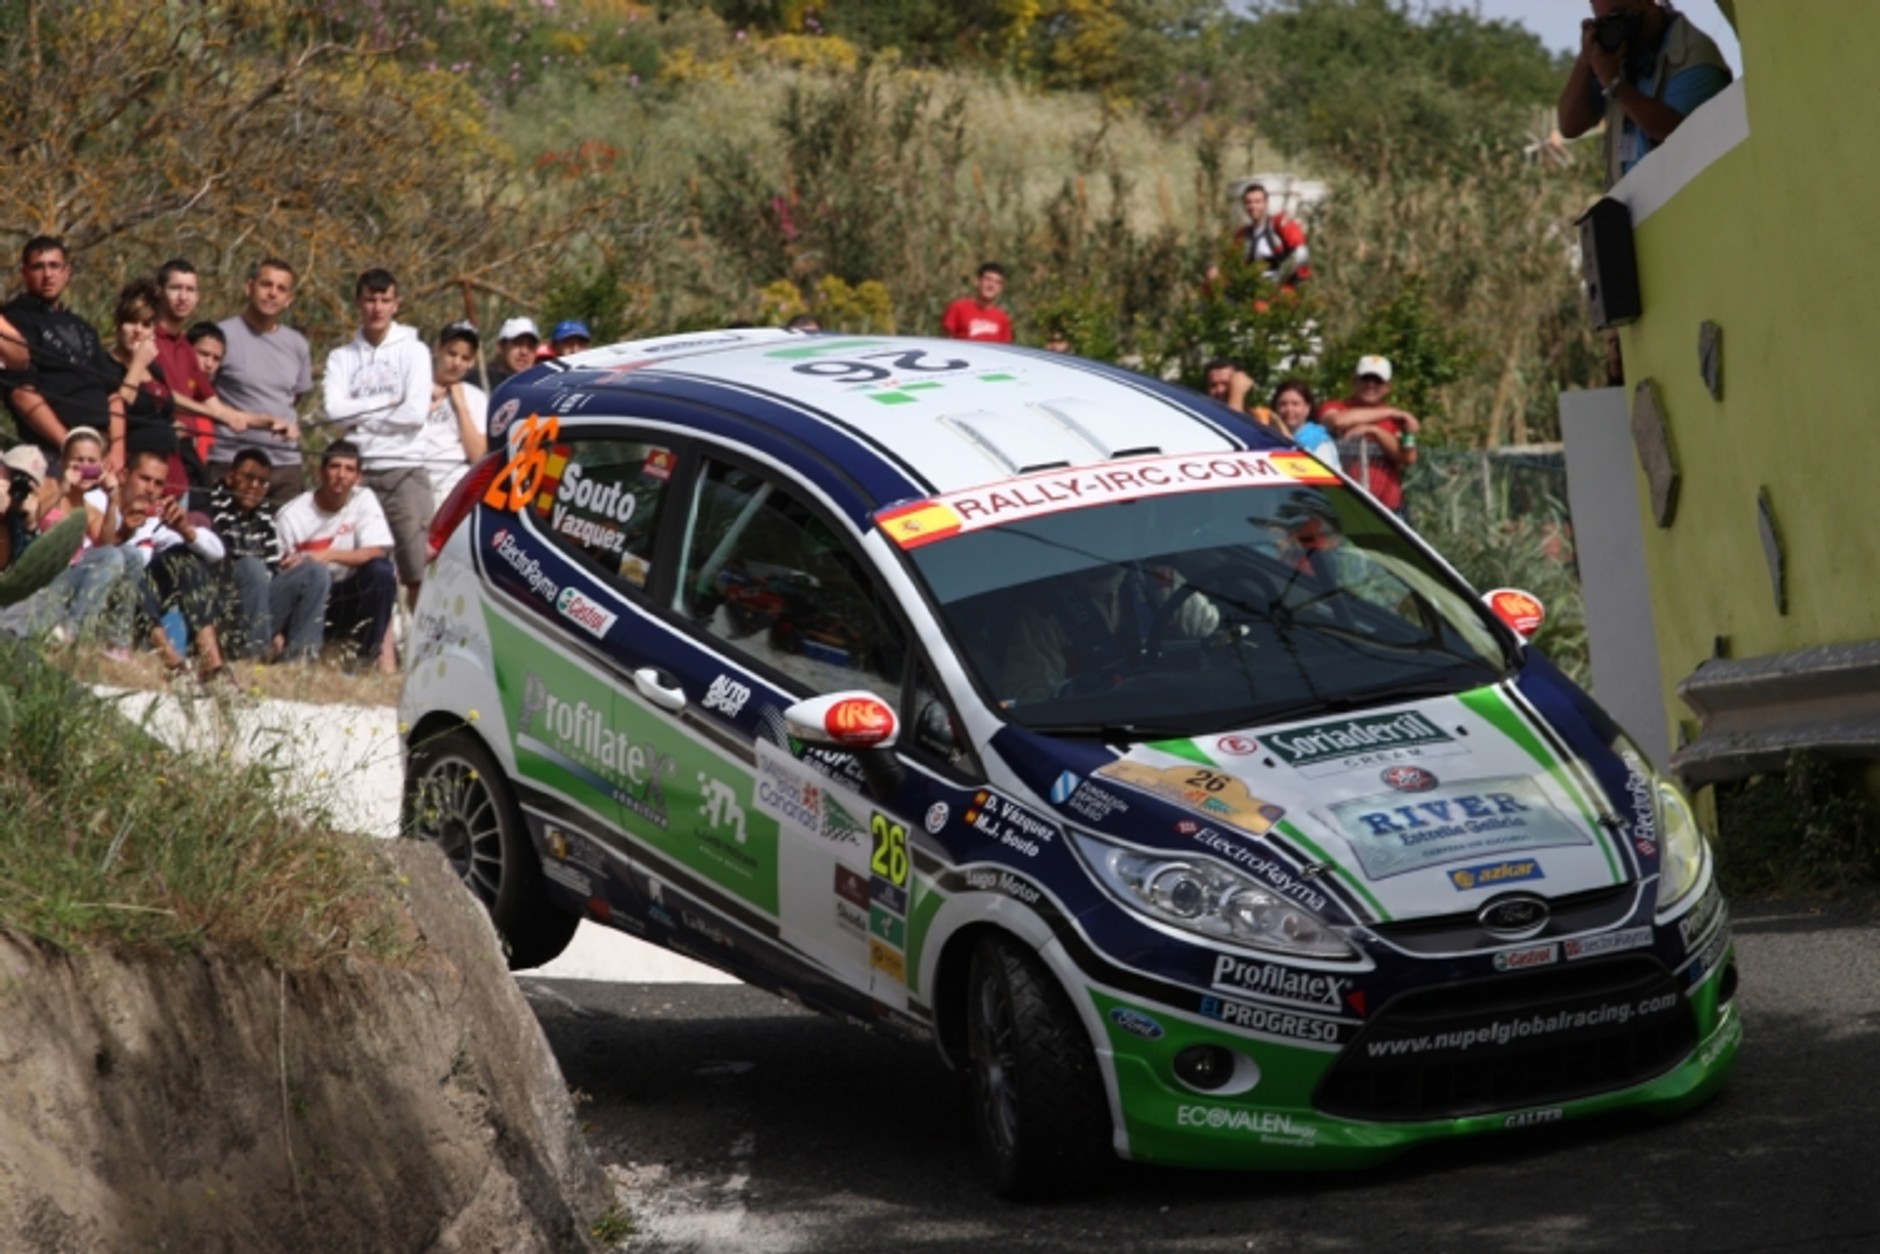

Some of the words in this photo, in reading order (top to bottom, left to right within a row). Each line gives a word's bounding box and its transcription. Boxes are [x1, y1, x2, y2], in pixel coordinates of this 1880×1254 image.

[791, 348, 970, 384] 26
[484, 413, 561, 512] 26
[558, 462, 636, 523] Souto
[952, 456, 1279, 521] RALLY-IRC.COM
[552, 503, 627, 553] Vazquez
[565, 596, 608, 633] Castrol
[702, 688, 743, 719] SPORT
[710, 674, 751, 703] AUTO
[837, 701, 884, 729] IRC
[1186, 769, 1231, 793] 26
[984, 795, 998, 813] D.
[1359, 793, 1532, 836] RIVER
[1001, 828, 1040, 857] Souto
[1401, 822, 1467, 846] Estrella
[1465, 816, 1527, 834] Galicia
[871, 815, 910, 886] 26
[966, 869, 997, 889] Lugo
[999, 872, 1041, 904] Motor
[1193, 827, 1327, 912] ElectroRayma
[1507, 948, 1552, 967] Castrol
[1117, 1009, 1156, 1035] Ford
[1202, 997, 1220, 1018] EL
[1222, 1002, 1339, 1042] PROGRESO
[1367, 993, 1678, 1058] www.nupelglobalracing.com
